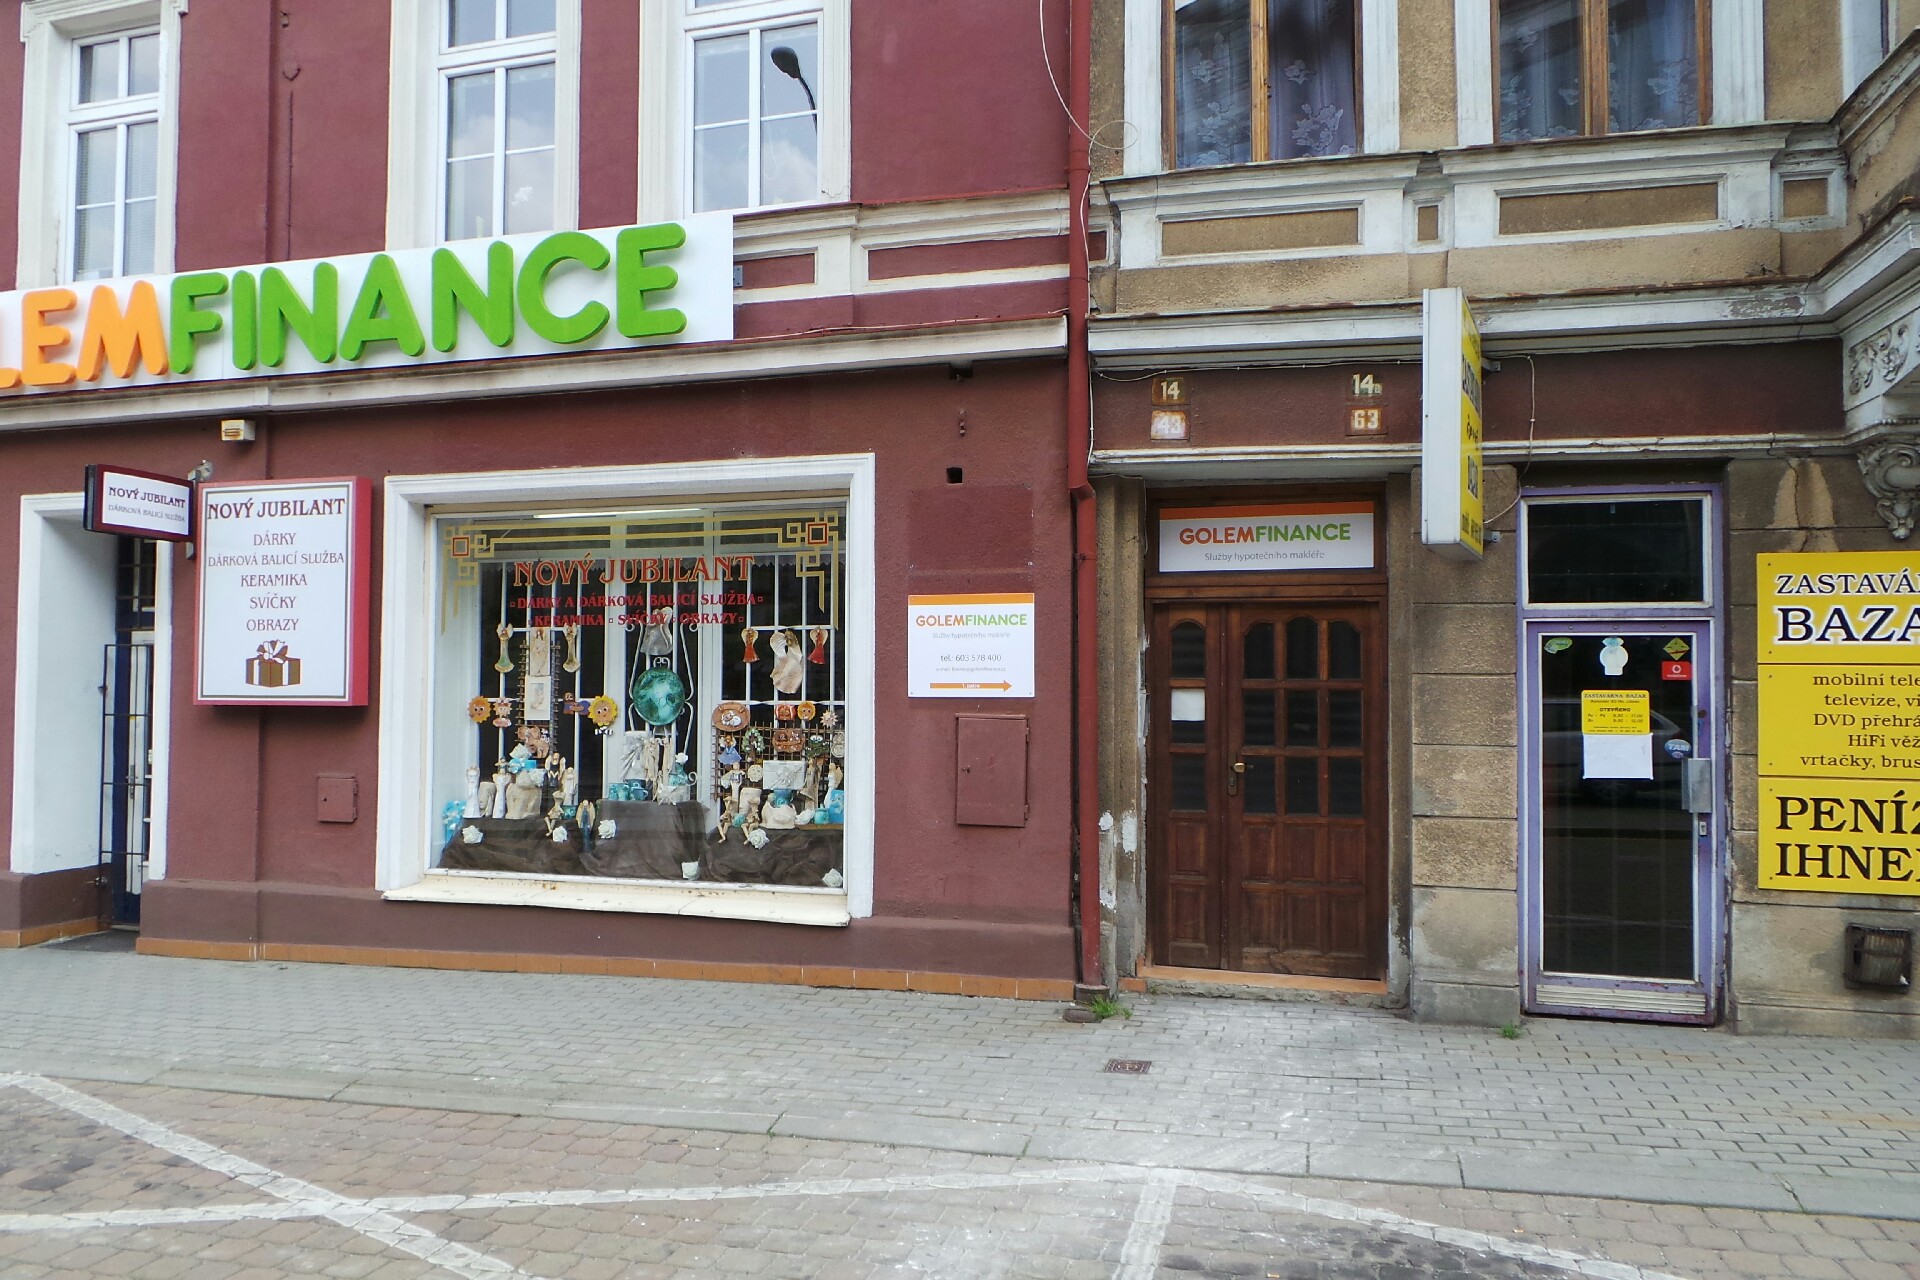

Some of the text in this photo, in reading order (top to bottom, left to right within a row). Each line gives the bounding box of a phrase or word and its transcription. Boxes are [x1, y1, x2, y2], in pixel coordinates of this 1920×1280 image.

[0, 222, 687, 388] EMFINANCE
[1160, 381, 1181, 400] 14
[1353, 373, 1382, 396] 14a
[1157, 415, 1182, 434] 43
[1353, 409, 1379, 429] 63
[108, 486, 186, 508] NOVÝ JUBILANT
[108, 504, 141, 515] DÁRKOVÁ
[164, 512, 186, 522] SLUŽBA
[207, 497, 346, 519] NOVÝ JUBILANT
[253, 530, 297, 546] DÁRKY
[1179, 523, 1352, 545] GOLEMFINANCE
[208, 550, 345, 567] DÁRKOVÁ BALICÍ SLUŽBA
[1204, 550, 1326, 562] Služby hypotečního makléře
[513, 552, 756, 587] NOVÝ JUBILANT
[241, 573, 308, 588] KERAMIKA
[1775, 567, 1920, 595] ZASTAVÁ
[249, 591, 297, 609] SVÍČKY
[517, 594, 560, 609] DÁRKY
[564, 597, 575, 608] A
[579, 591, 644, 608] DÁRKOVÁ
[700, 589, 757, 606] SLUŽBA
[246, 618, 300, 631] OBRAZY
[533, 609, 738, 627] KERAMIKA SVÍČKY OBRAZY
[915, 613, 1028, 628] GOLEMFINANCE
[955, 654, 969, 662] 603
[971, 654, 986, 662] 578
[987, 654, 1002, 662] 400
[1812, 672, 1886, 686] mobilní
[1823, 693, 1901, 709] televize,
[1812, 713, 1920, 730] DVD přehrá
[1847, 734, 1887, 748] HiFi
[1799, 754, 1920, 771] vrtačky, brus
[1775, 842, 1920, 882] IHNE
